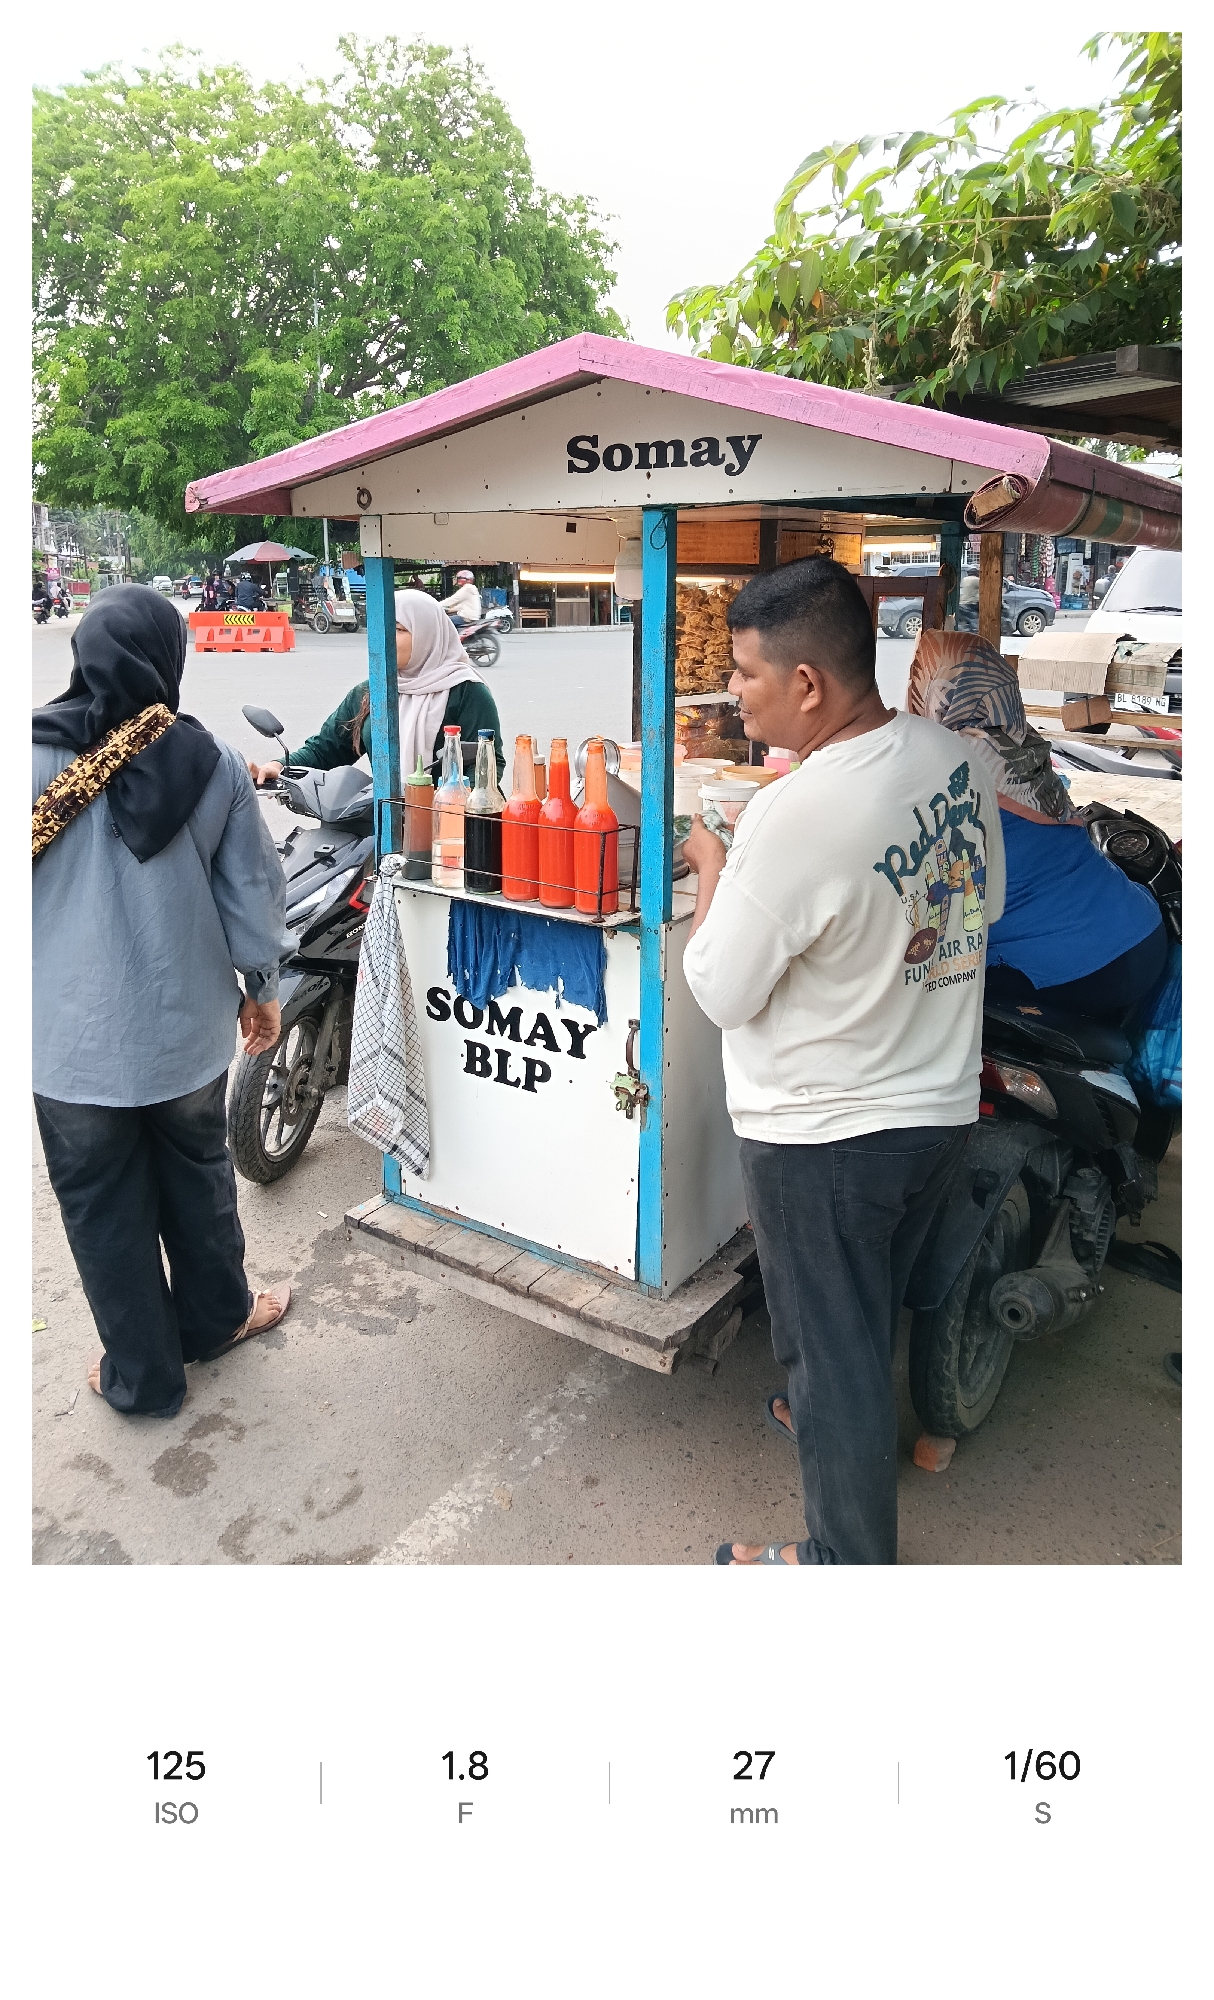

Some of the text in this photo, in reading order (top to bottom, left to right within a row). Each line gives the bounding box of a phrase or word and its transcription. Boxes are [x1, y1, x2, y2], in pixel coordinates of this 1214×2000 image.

[566, 433, 763, 477] Somay
[937, 968, 977, 988] COMPANY
[425, 986, 598, 1060] SOMAY
[462, 1038, 552, 1094] BLP
